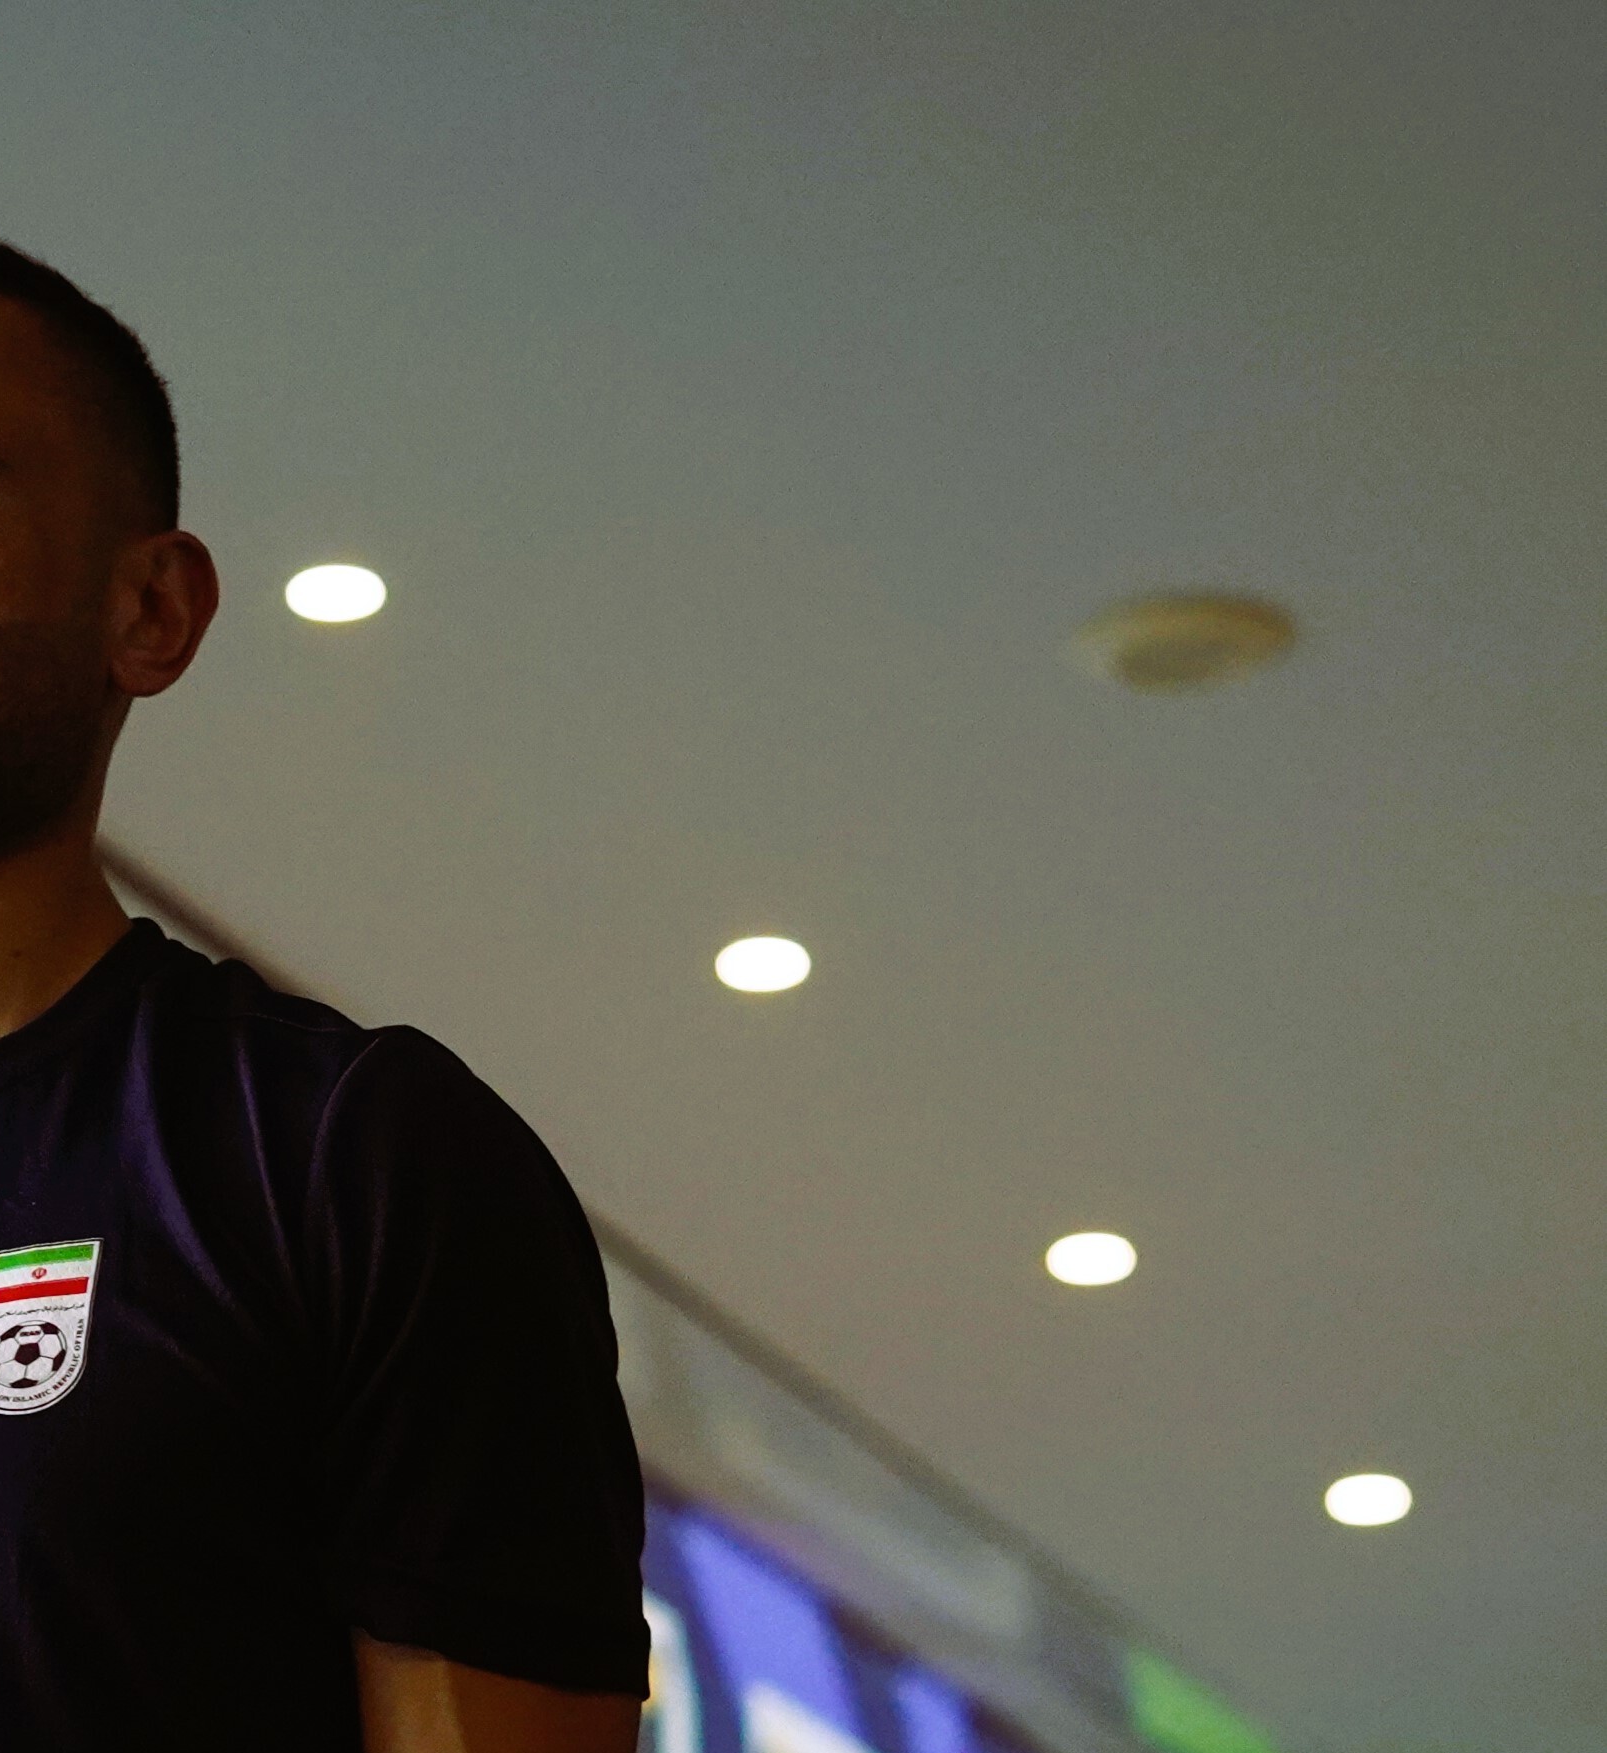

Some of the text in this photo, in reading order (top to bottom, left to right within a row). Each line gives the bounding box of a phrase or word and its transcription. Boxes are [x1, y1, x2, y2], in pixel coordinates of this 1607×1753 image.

[12, 1388, 51, 1402] ISLAMIC
[52, 1353, 80, 1391] REPUBLIC
[76, 1318, 85, 1338] IRAN
